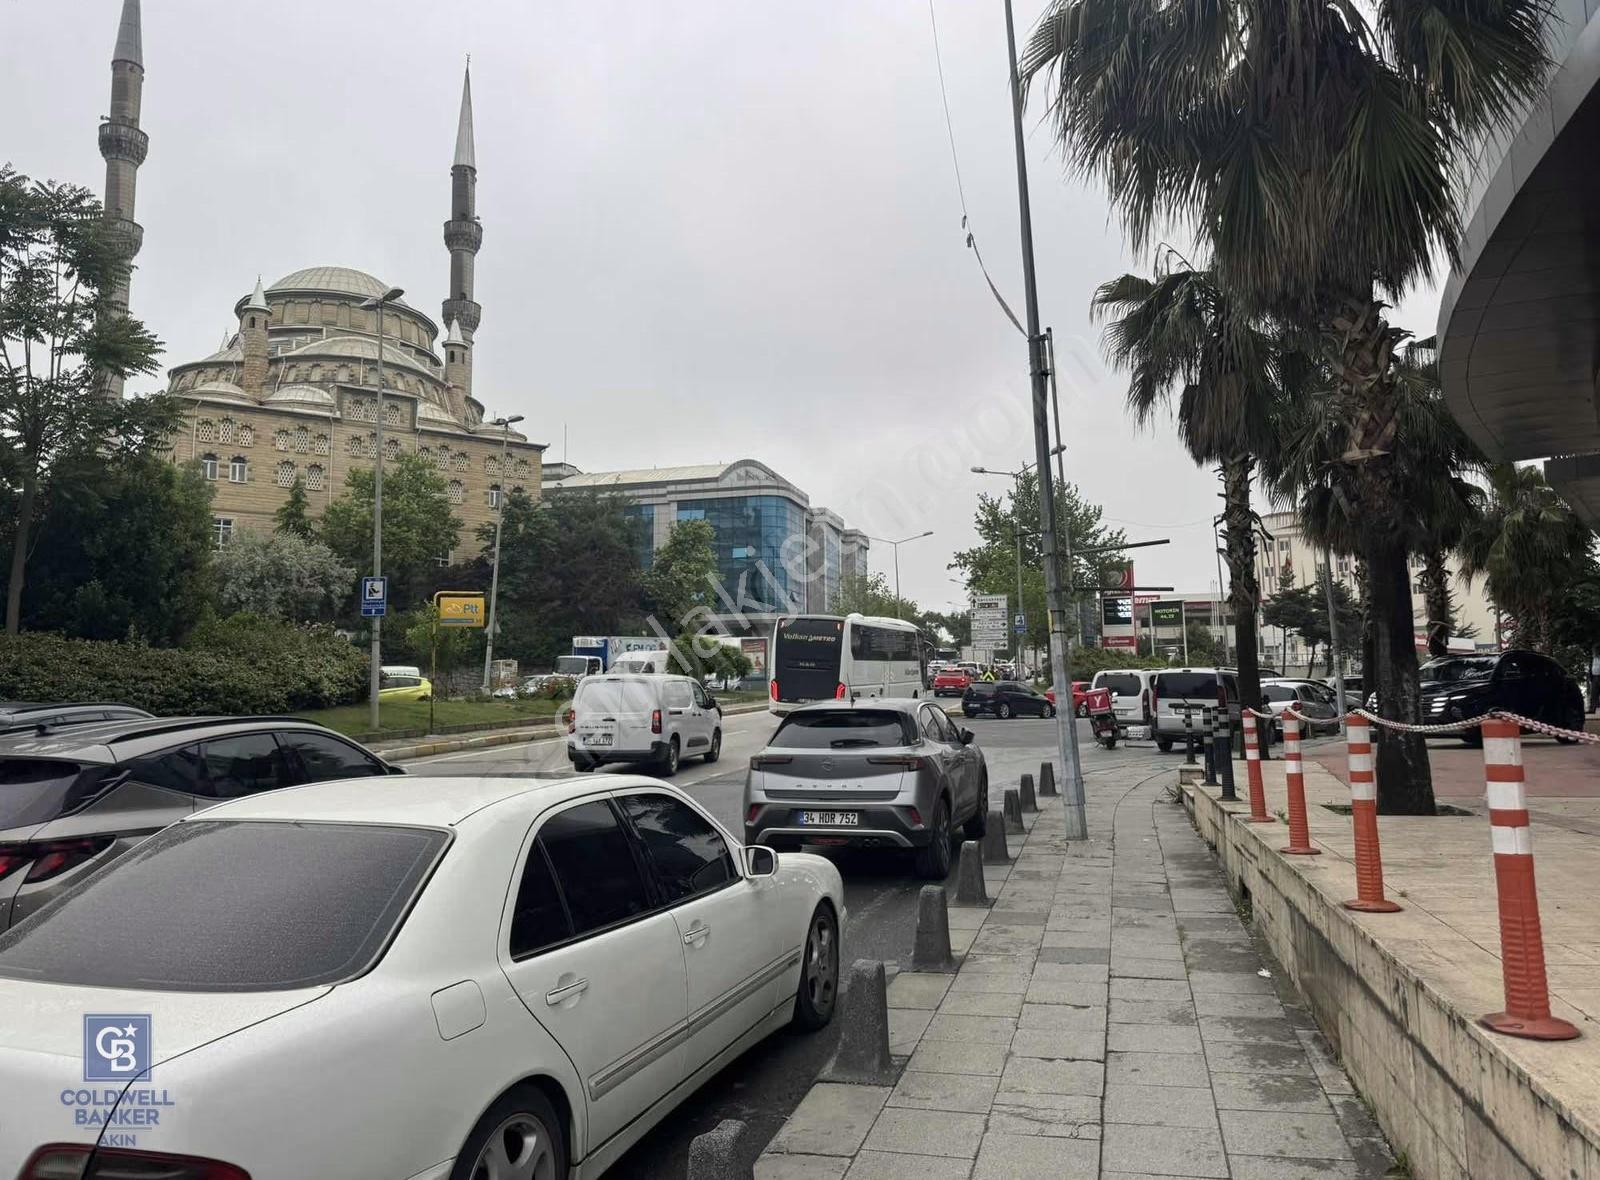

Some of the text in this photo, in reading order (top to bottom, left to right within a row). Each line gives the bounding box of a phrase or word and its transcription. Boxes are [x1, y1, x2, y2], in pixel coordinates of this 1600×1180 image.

[1094, 695, 1102, 708] Y
[803, 812, 857, 825] 34 HDR 752
